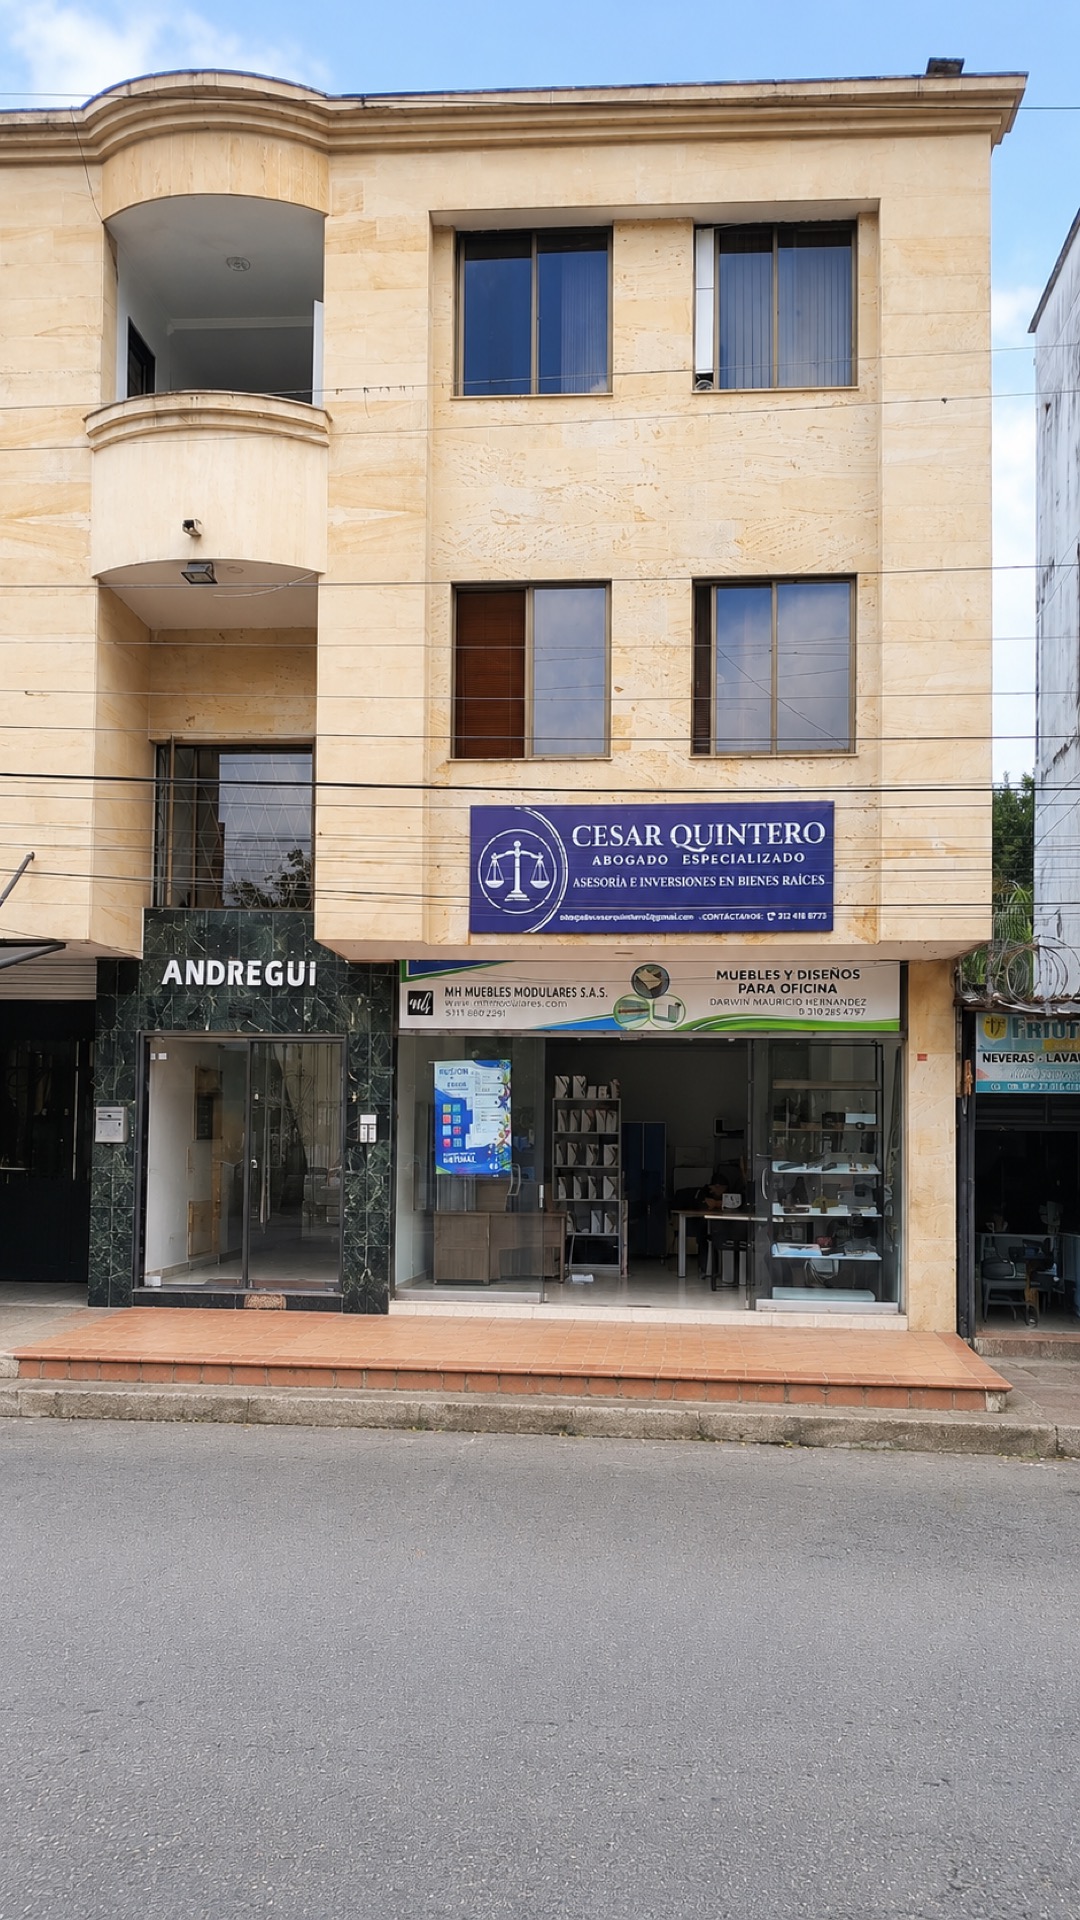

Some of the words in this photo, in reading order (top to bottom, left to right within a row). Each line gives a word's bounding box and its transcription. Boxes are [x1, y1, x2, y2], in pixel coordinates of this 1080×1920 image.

[572, 823, 664, 848] CESAR
[669, 821, 827, 853] QUINTERO
[592, 854, 669, 866] ABOGADO
[682, 852, 806, 865] ESPECIALIZADO
[573, 875, 628, 888] ASESORÍA
[630, 876, 638, 887] E
[640, 876, 716, 888] INVERSIONES
[719, 876, 735, 887] EN
[738, 875, 779, 887] BIENES
[782, 873, 826, 886] RAÍCES
[161, 959, 317, 987] ANDREGUI
[716, 970, 781, 981] MUEBLES
[784, 970, 793, 980] Y
[797, 967, 861, 981] DISEÑOS
[444, 987, 462, 998] MH
[465, 986, 511, 998] MUEBLES
[514, 986, 577, 998] MODULARES
[580, 986, 609, 998] S.A.S.
[738, 983, 776, 994] PARA
[780, 983, 838, 994] OFICINA
[710, 998, 750, 1006] DARWIN
[753, 998, 803, 1006] MAURICIO
[982, 1052, 1035, 1063] NEVERAS
